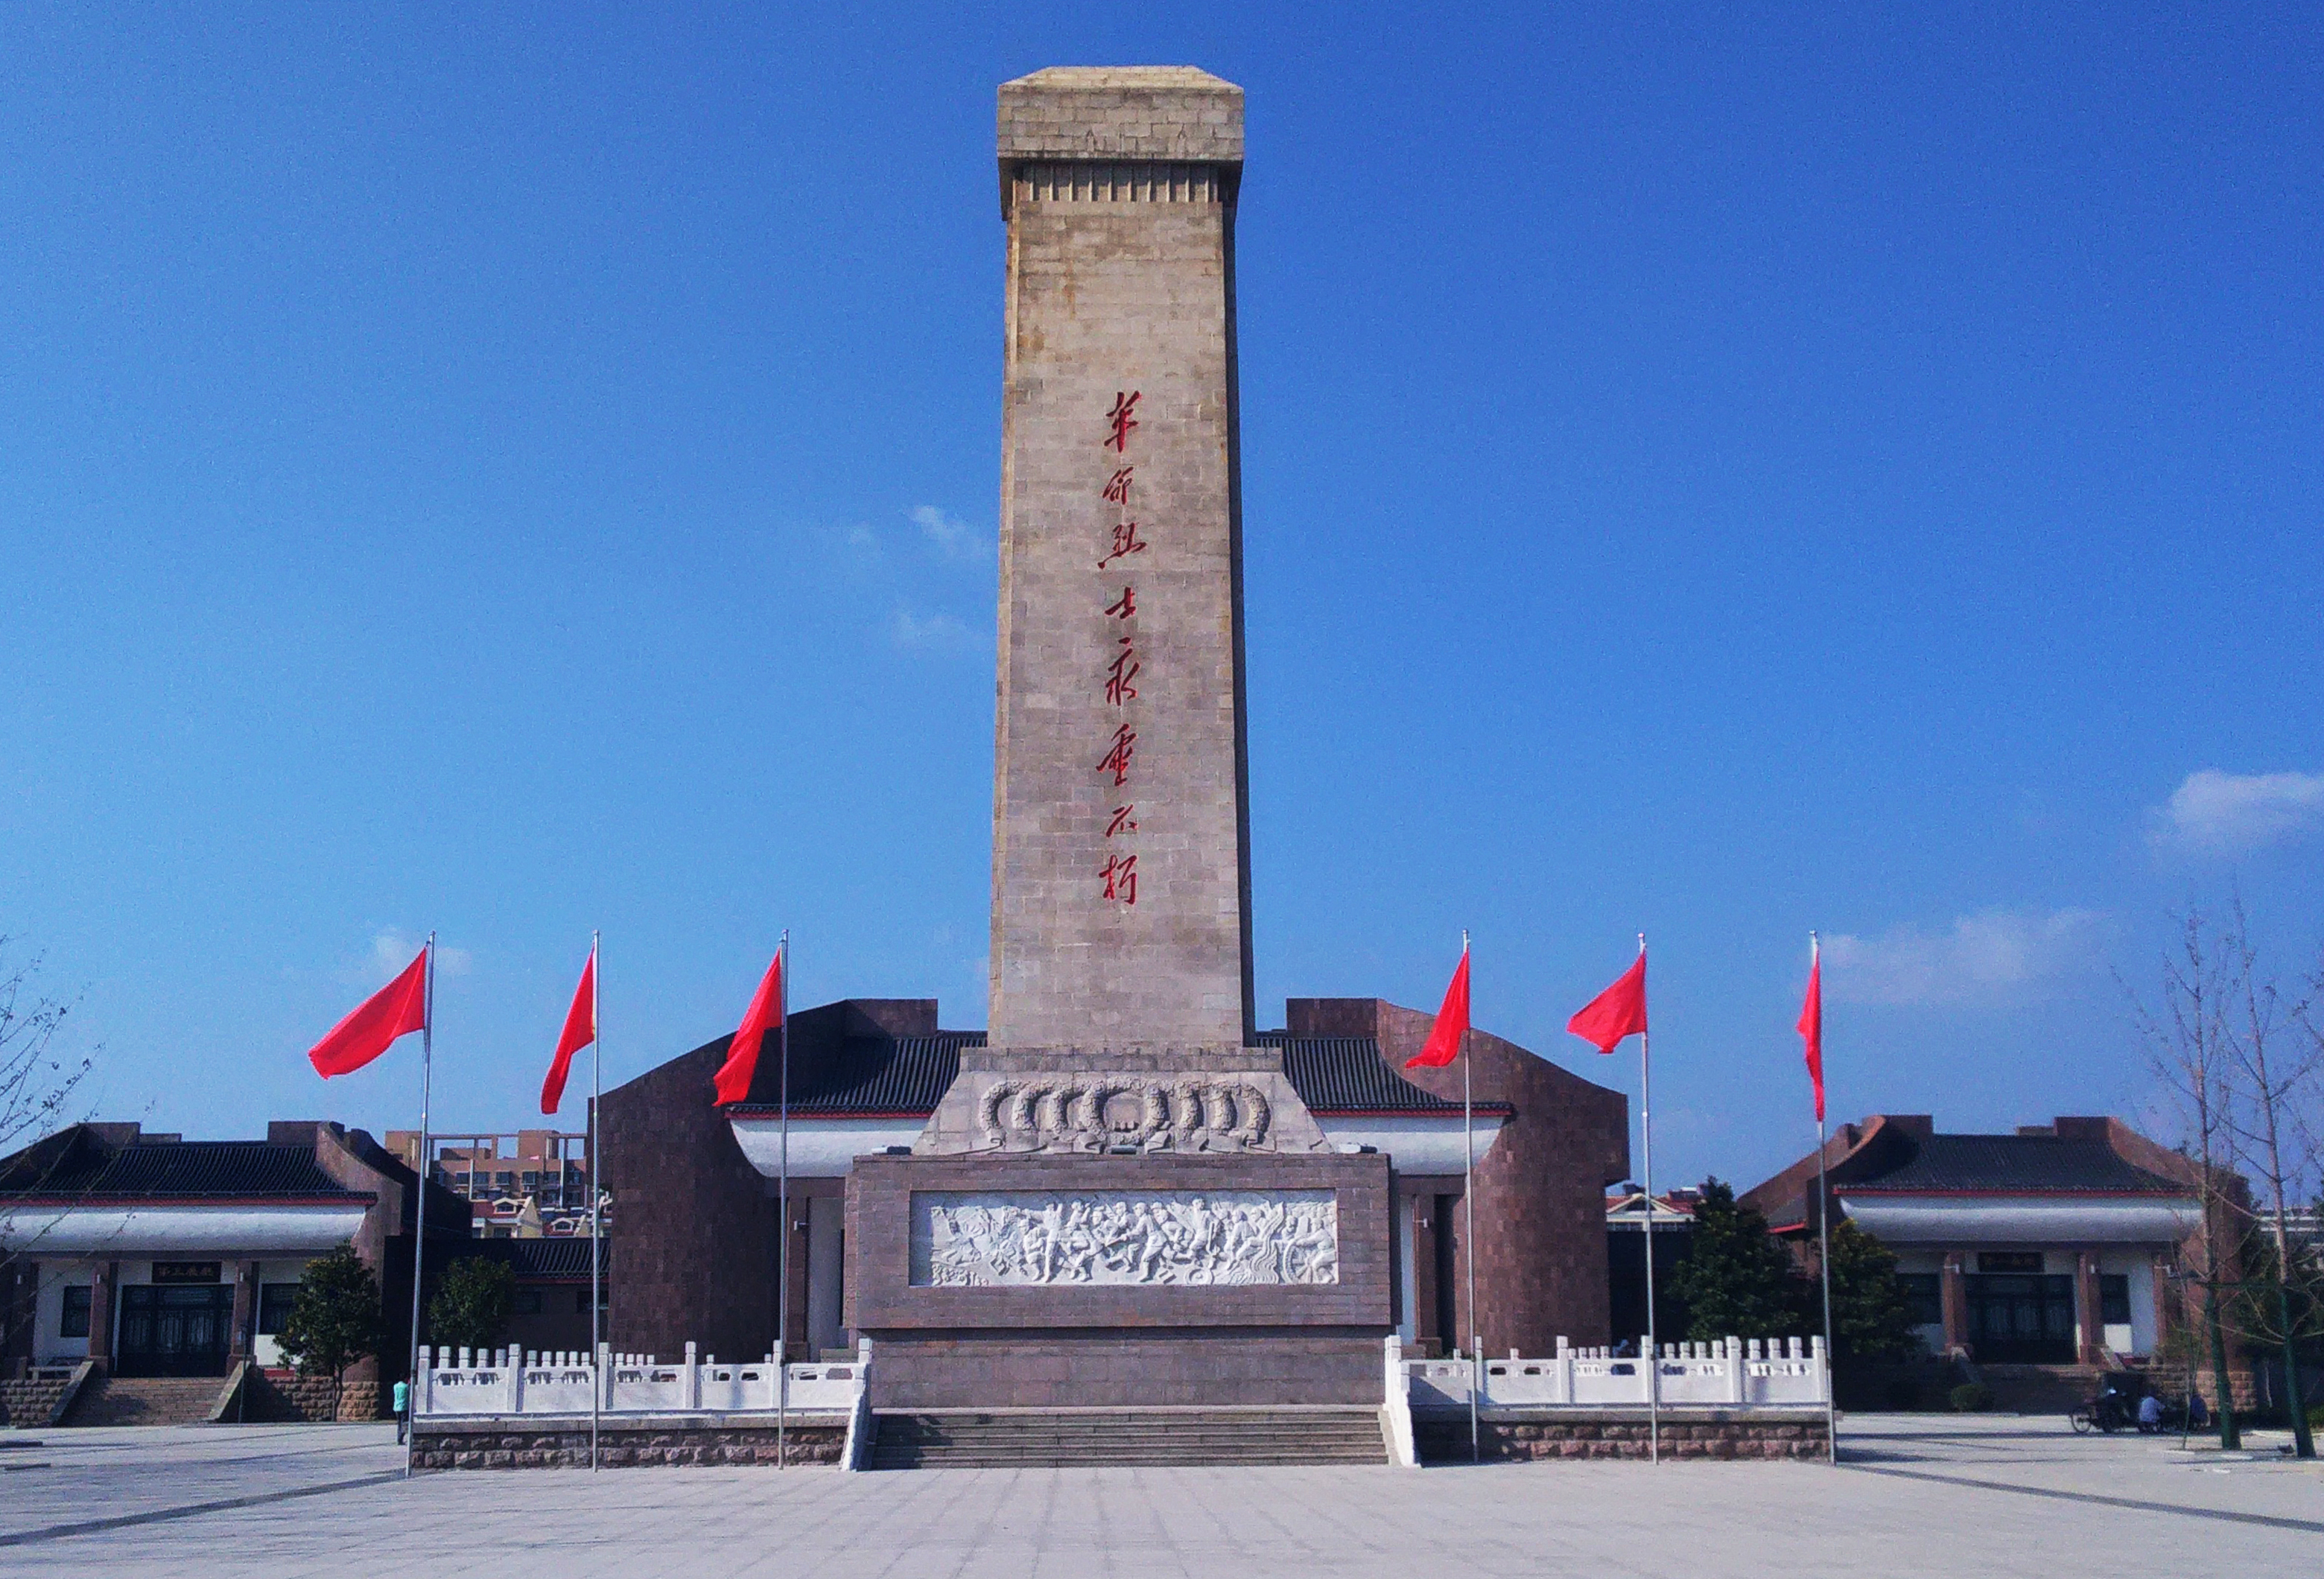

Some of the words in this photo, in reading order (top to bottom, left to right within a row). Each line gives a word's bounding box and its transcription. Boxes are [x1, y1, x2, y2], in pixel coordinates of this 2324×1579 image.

[1096, 390, 1147, 906] 革命烈士永垂不朽
